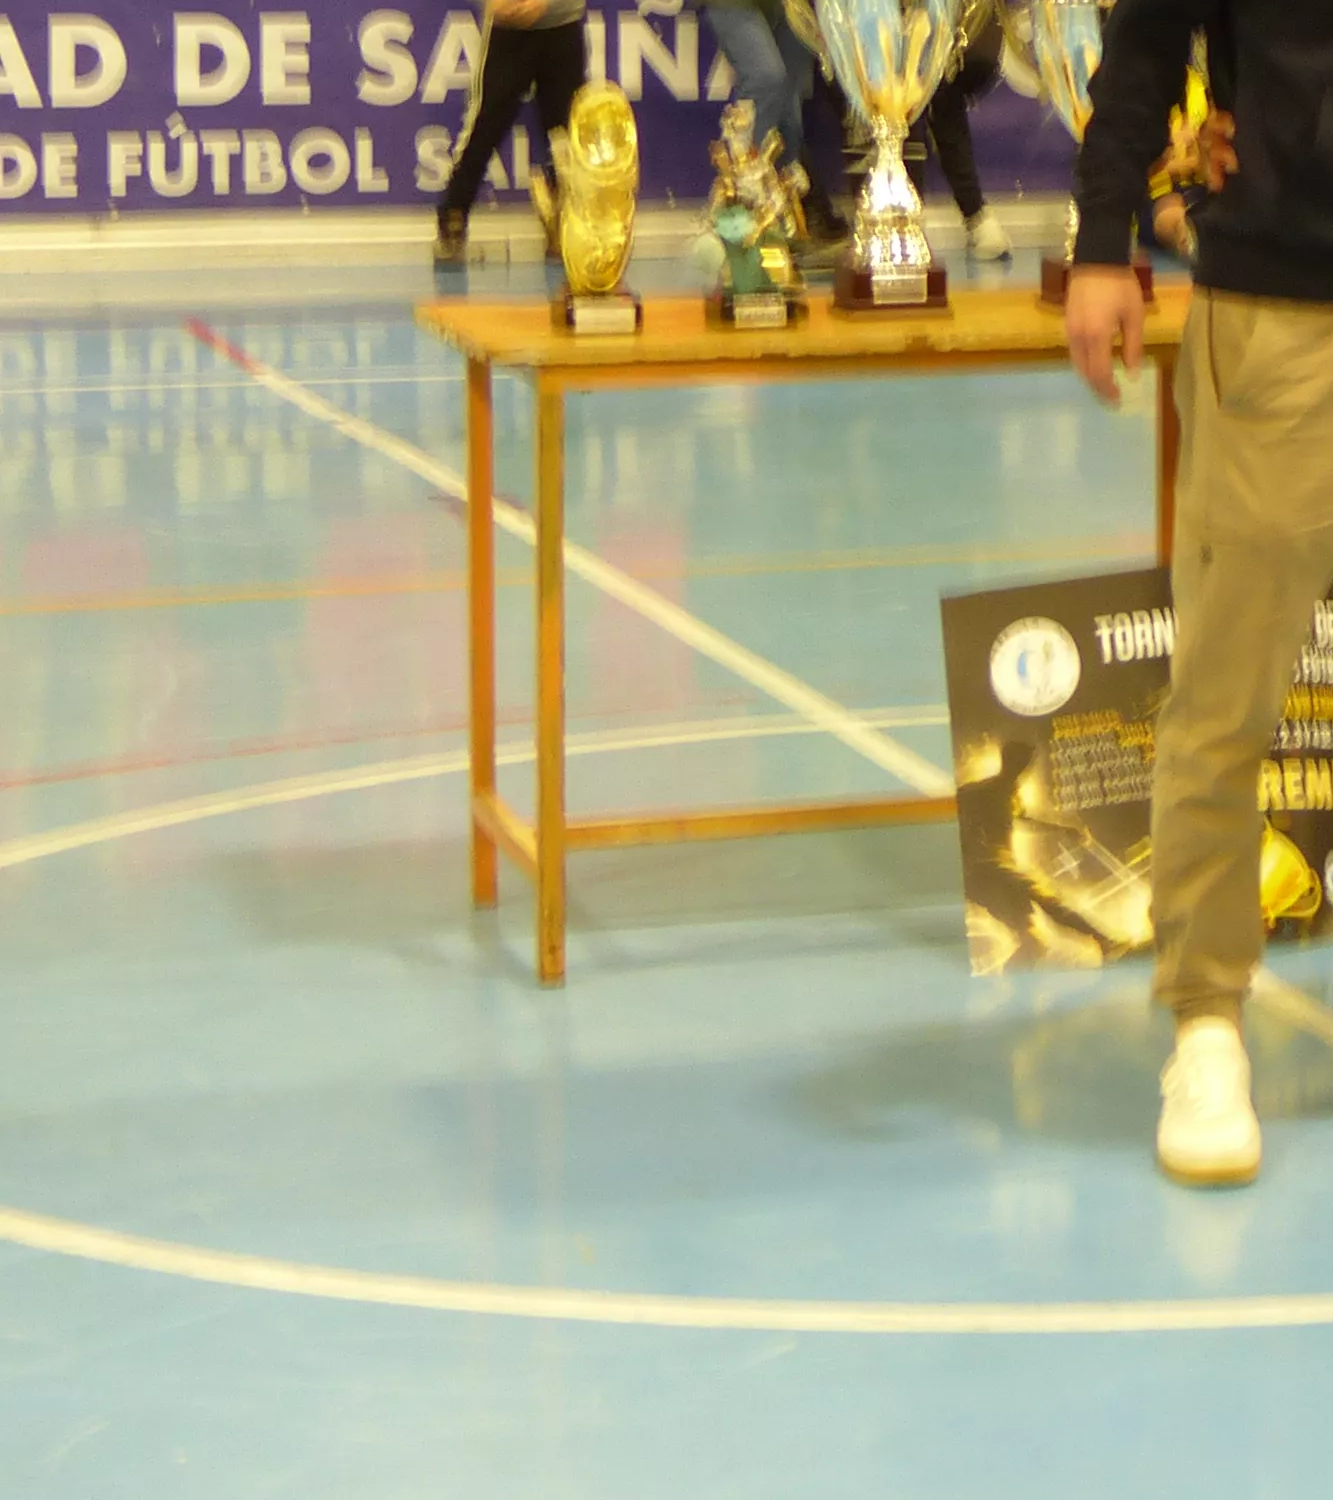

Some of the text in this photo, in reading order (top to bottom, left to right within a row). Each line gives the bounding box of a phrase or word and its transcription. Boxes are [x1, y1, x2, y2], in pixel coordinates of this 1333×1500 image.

[173, 11, 311, 106] DE
[107, 110, 389, 198] FÚTBOL
[1094, 606, 1177, 665] TORN
